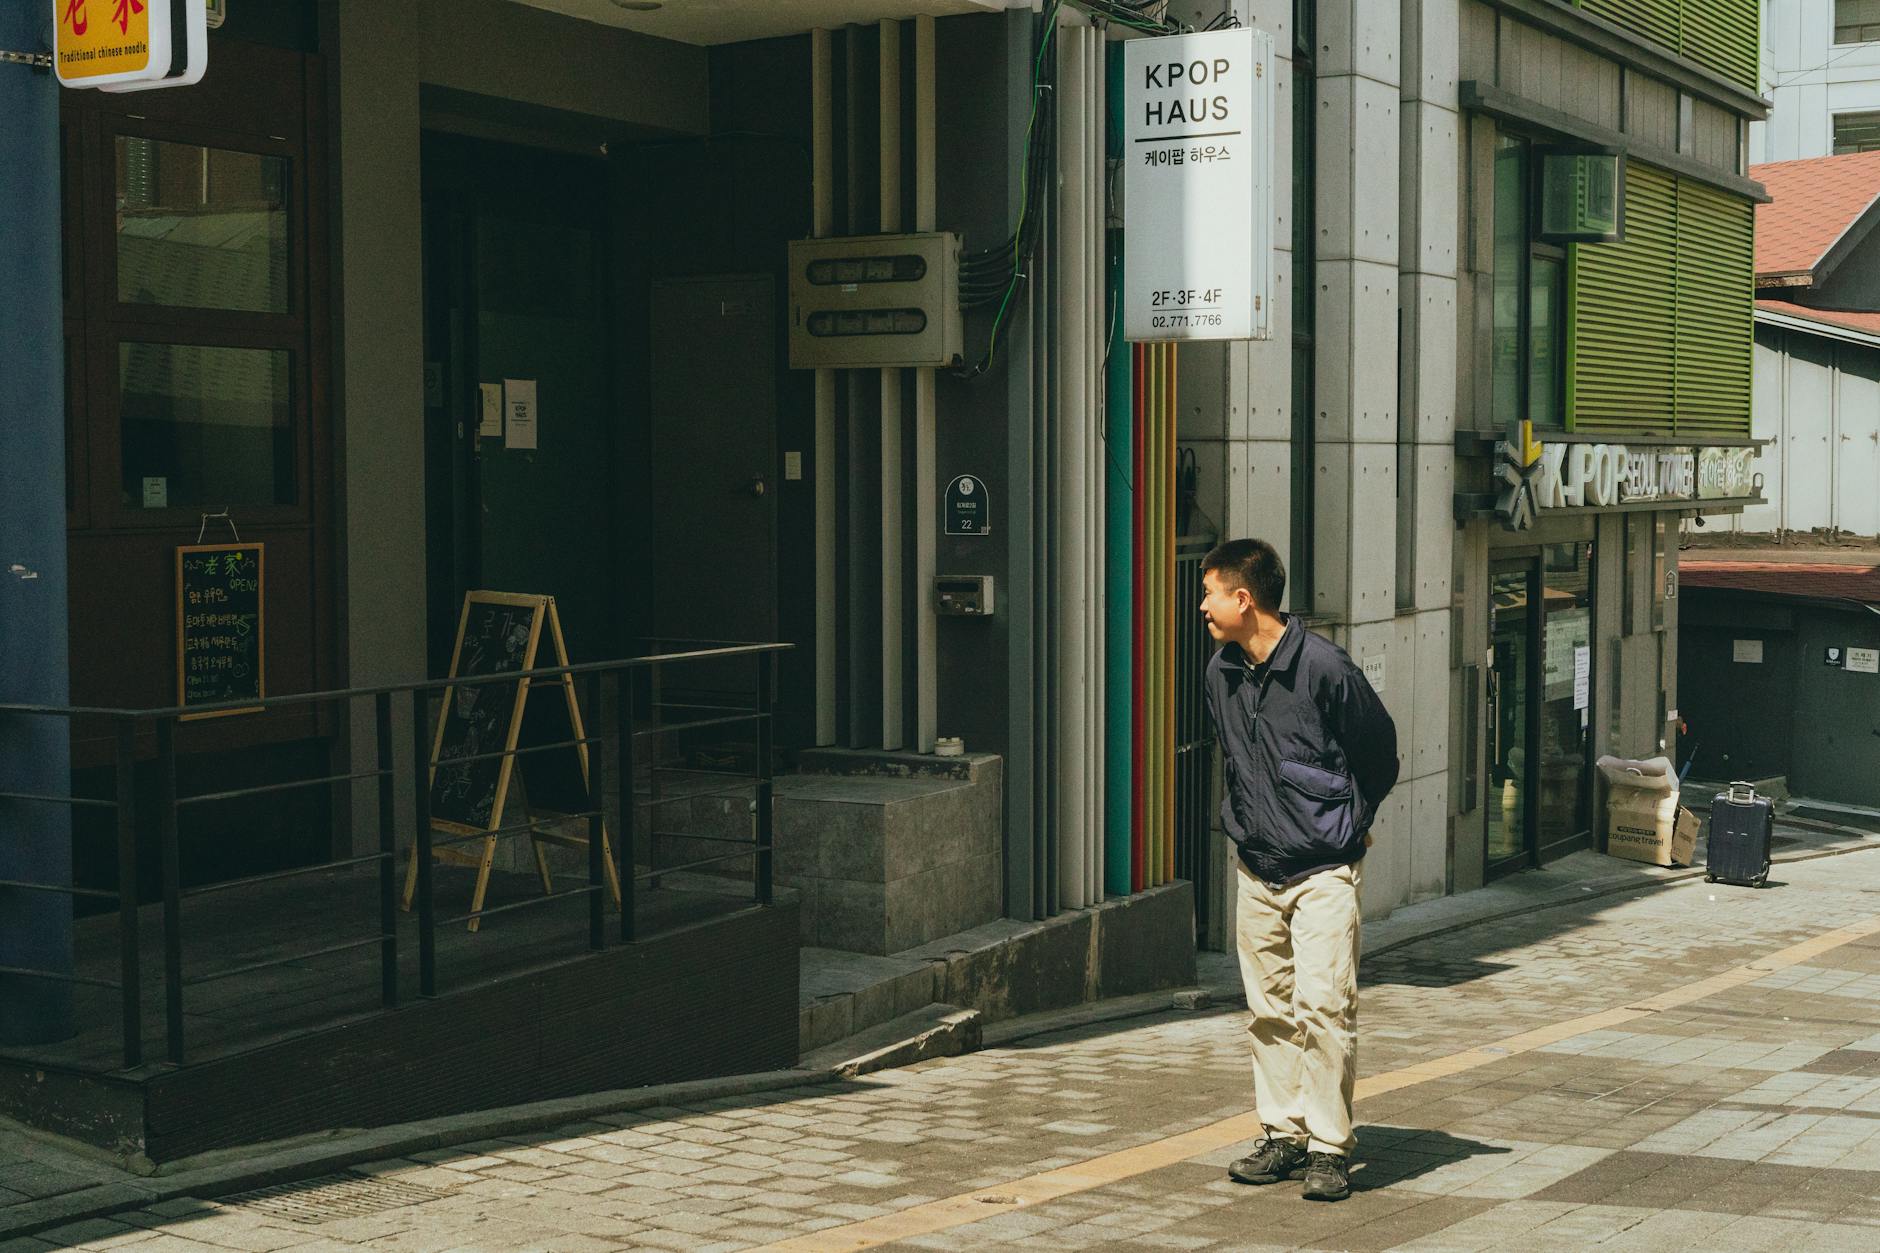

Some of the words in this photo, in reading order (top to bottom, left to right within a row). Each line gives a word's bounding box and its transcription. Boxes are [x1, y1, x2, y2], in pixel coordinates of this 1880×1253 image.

[60, 47, 96, 64] Traditional
[98, 45, 123, 59] chinese
[124, 41, 147, 56] noodle
[1145, 58, 1230, 90] KPOP
[1145, 95, 1229, 126] HAUS
[1144, 148, 1185, 167] 케이팝
[1189, 146, 1231, 165] 하우스
[1152, 314, 1222, 329] 02.771.7766
[1539, 442, 1628, 508] K-POP
[1626, 452, 1657, 496] SEOUL
[1658, 452, 1694, 494] TOWER
[961, 519, 972, 530] 22
[1642, 836, 1664, 847] travel
